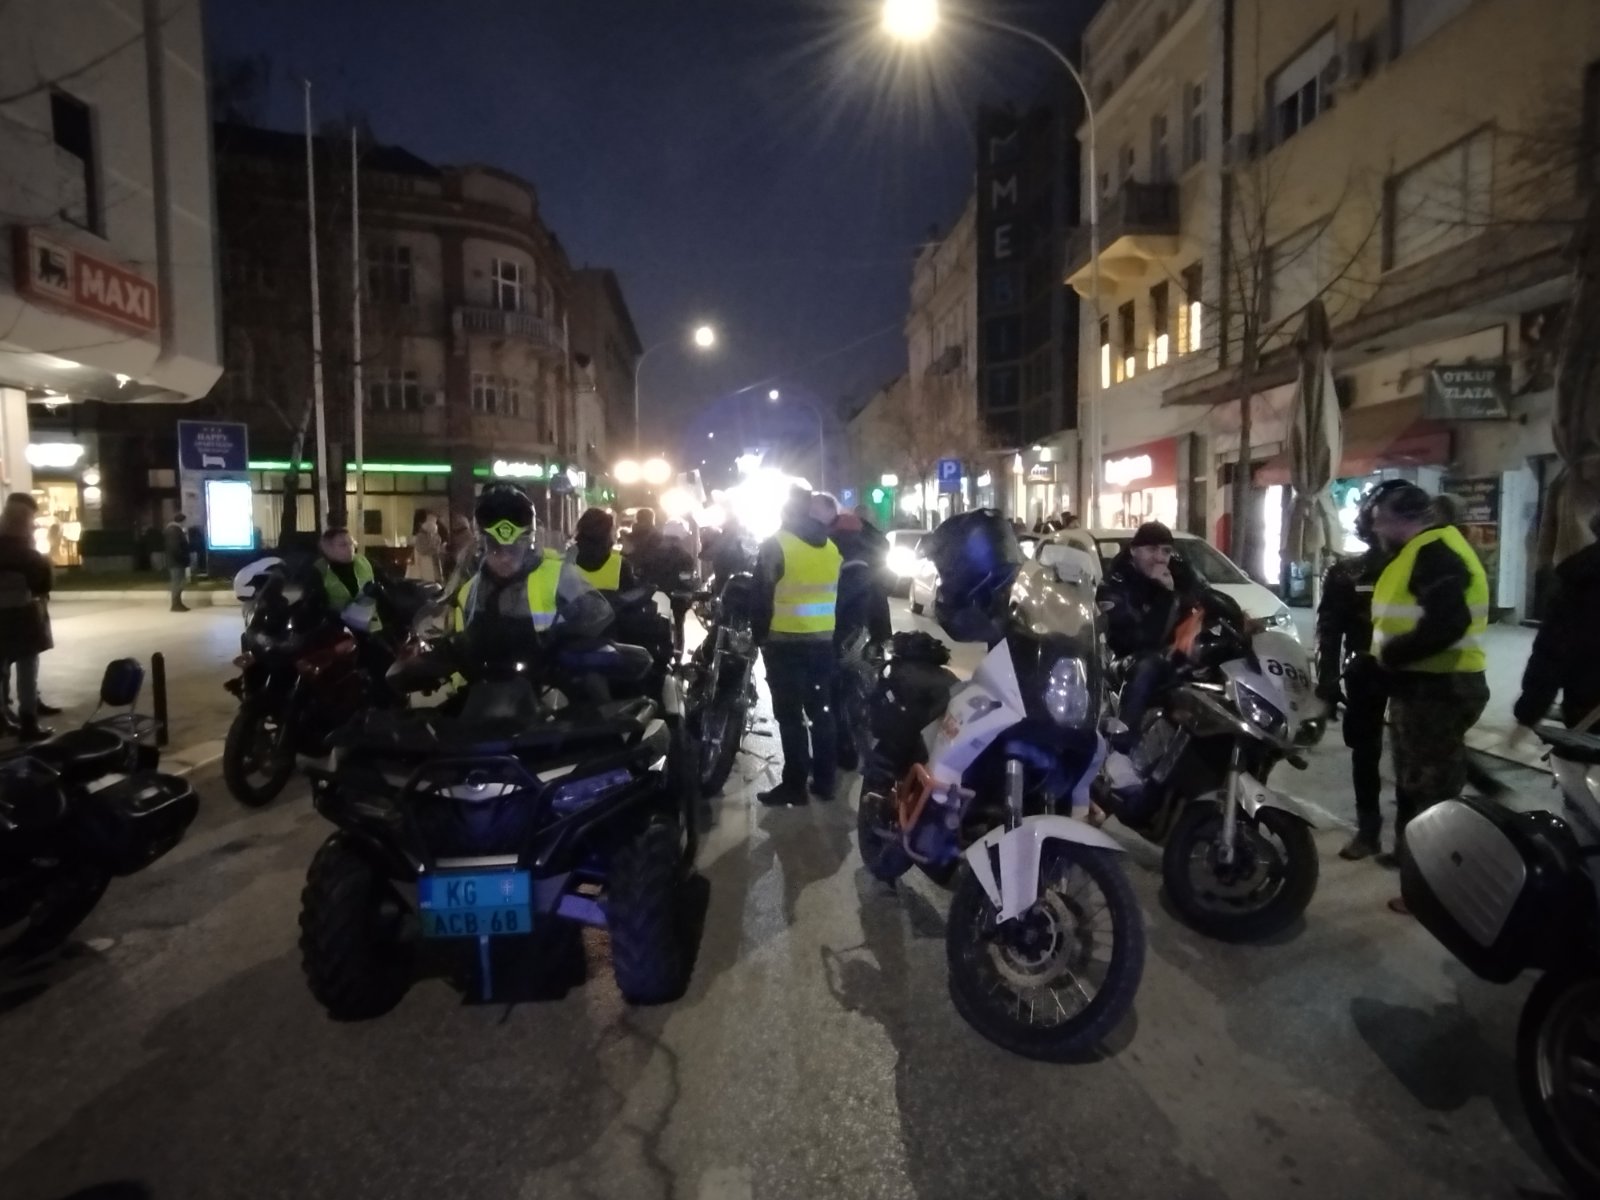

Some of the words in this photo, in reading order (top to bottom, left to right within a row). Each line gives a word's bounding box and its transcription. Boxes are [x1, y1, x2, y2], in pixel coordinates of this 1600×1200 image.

[80, 263, 151, 321] MAXI
[1442, 371, 1496, 383] OTKUP
[943, 461, 956, 479] P
[447, 881, 477, 906] KG
